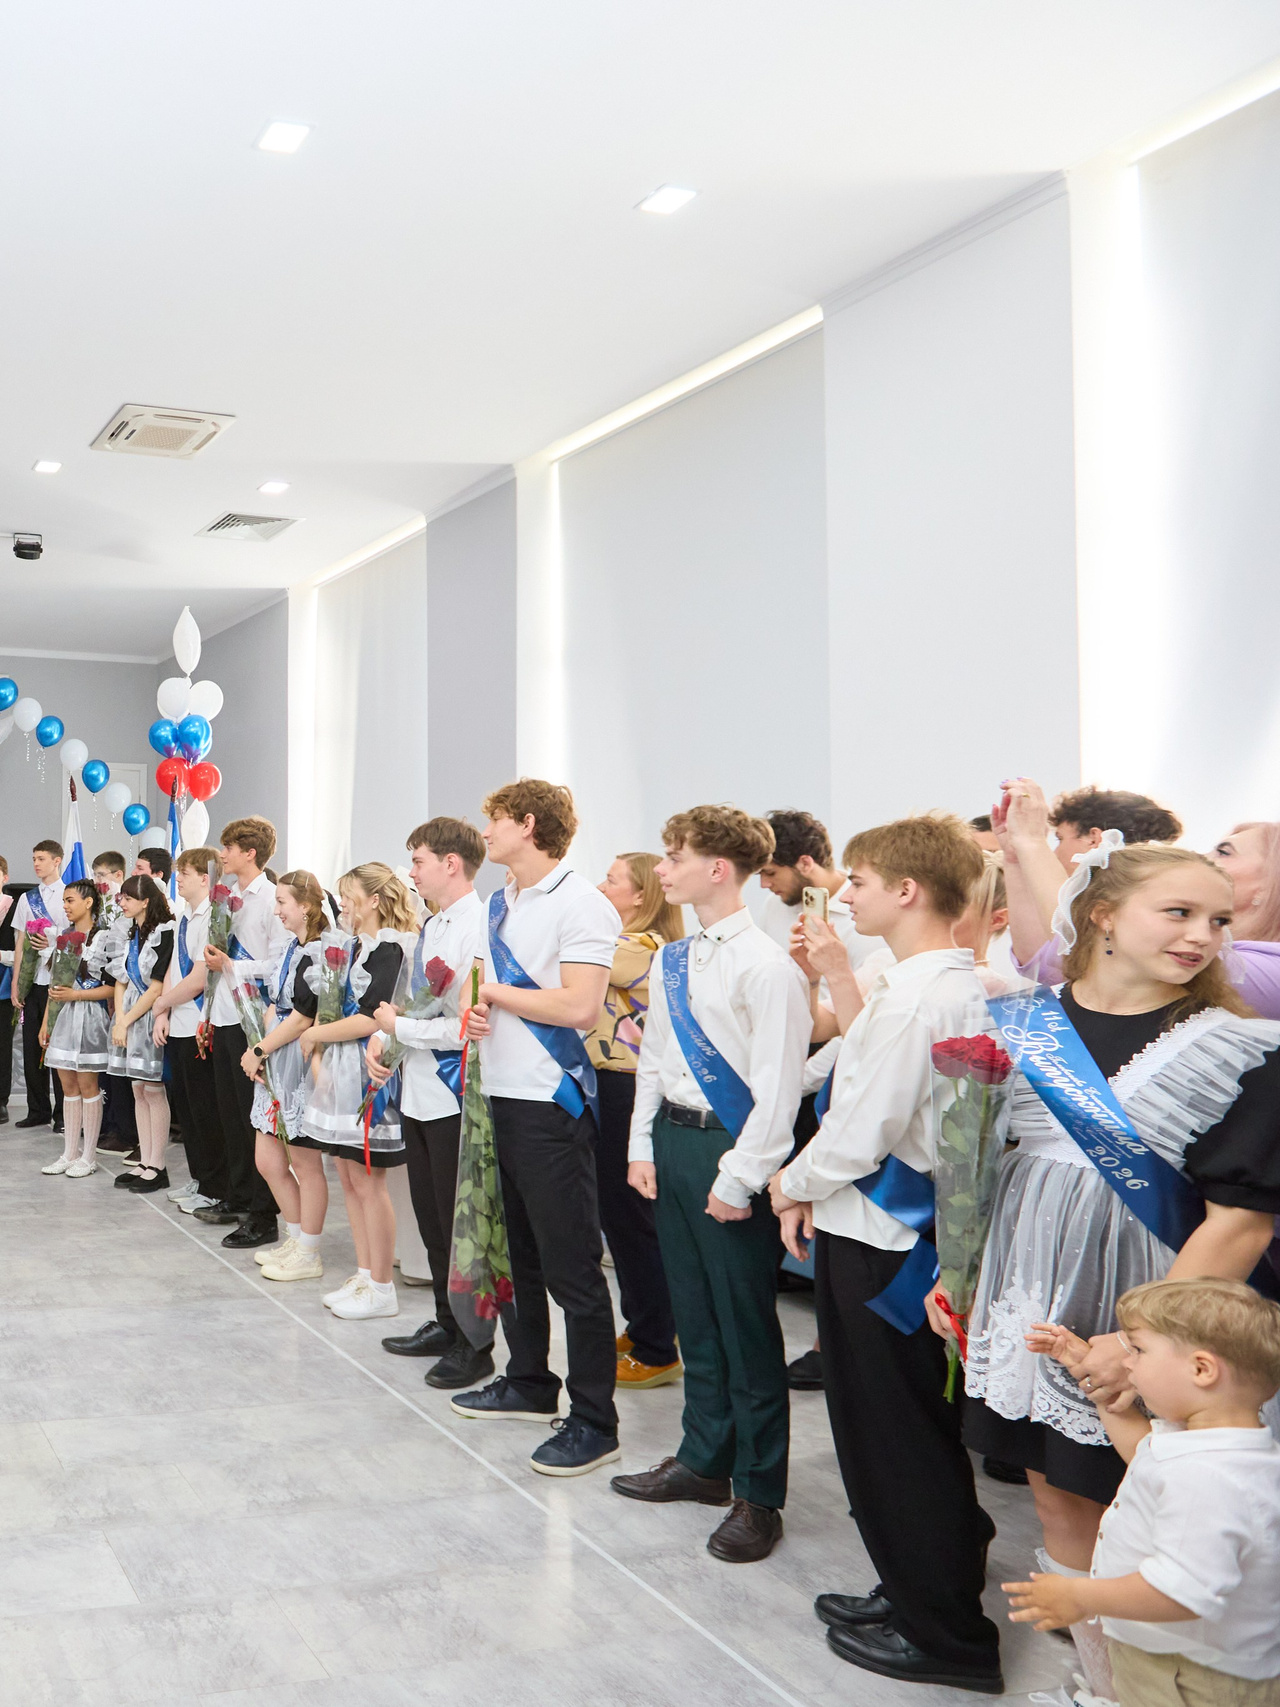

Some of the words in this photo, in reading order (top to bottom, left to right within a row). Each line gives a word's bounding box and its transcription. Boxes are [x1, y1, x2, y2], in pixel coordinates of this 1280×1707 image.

[687, 1053, 718, 1083] 2026
[1001, 1024, 1150, 1156] Выпускница
[1086, 1145, 1150, 1190] 2026
